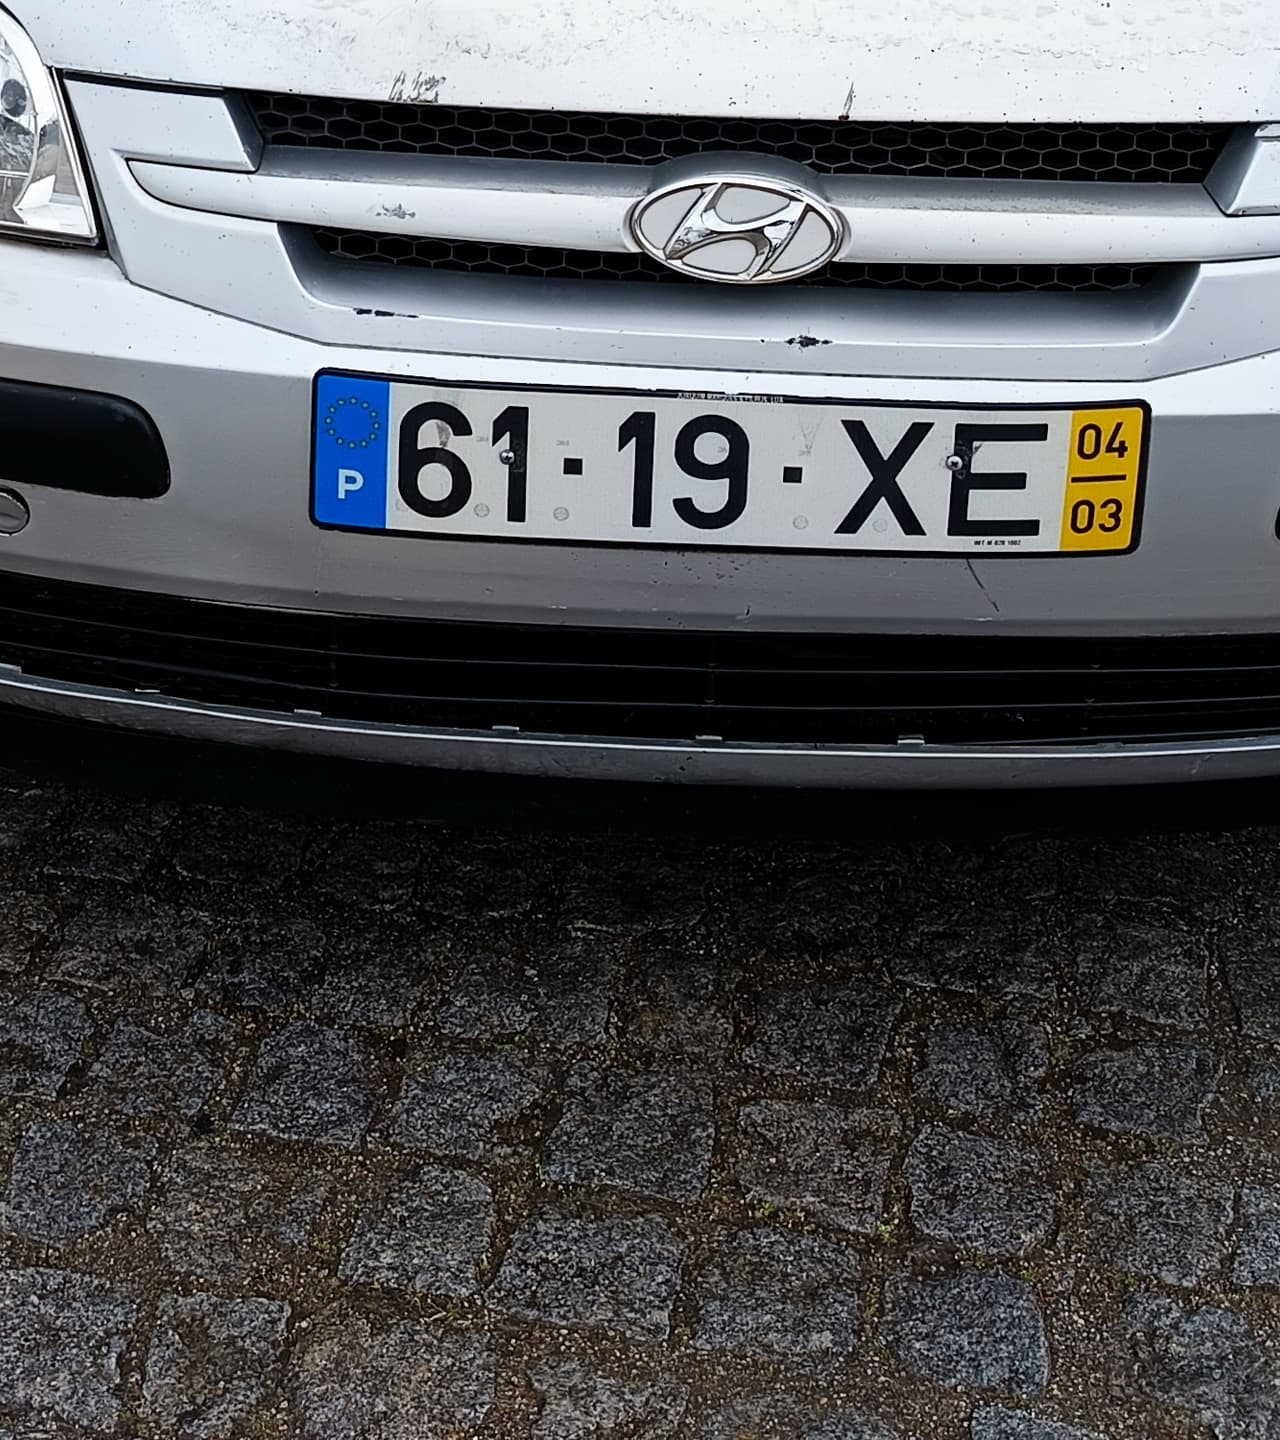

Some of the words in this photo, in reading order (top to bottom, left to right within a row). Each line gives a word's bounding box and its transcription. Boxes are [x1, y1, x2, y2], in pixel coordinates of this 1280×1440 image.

[1077, 421, 1129, 461] 04
[338, 468, 364, 499] P
[1070, 497, 1123, 535] 03
